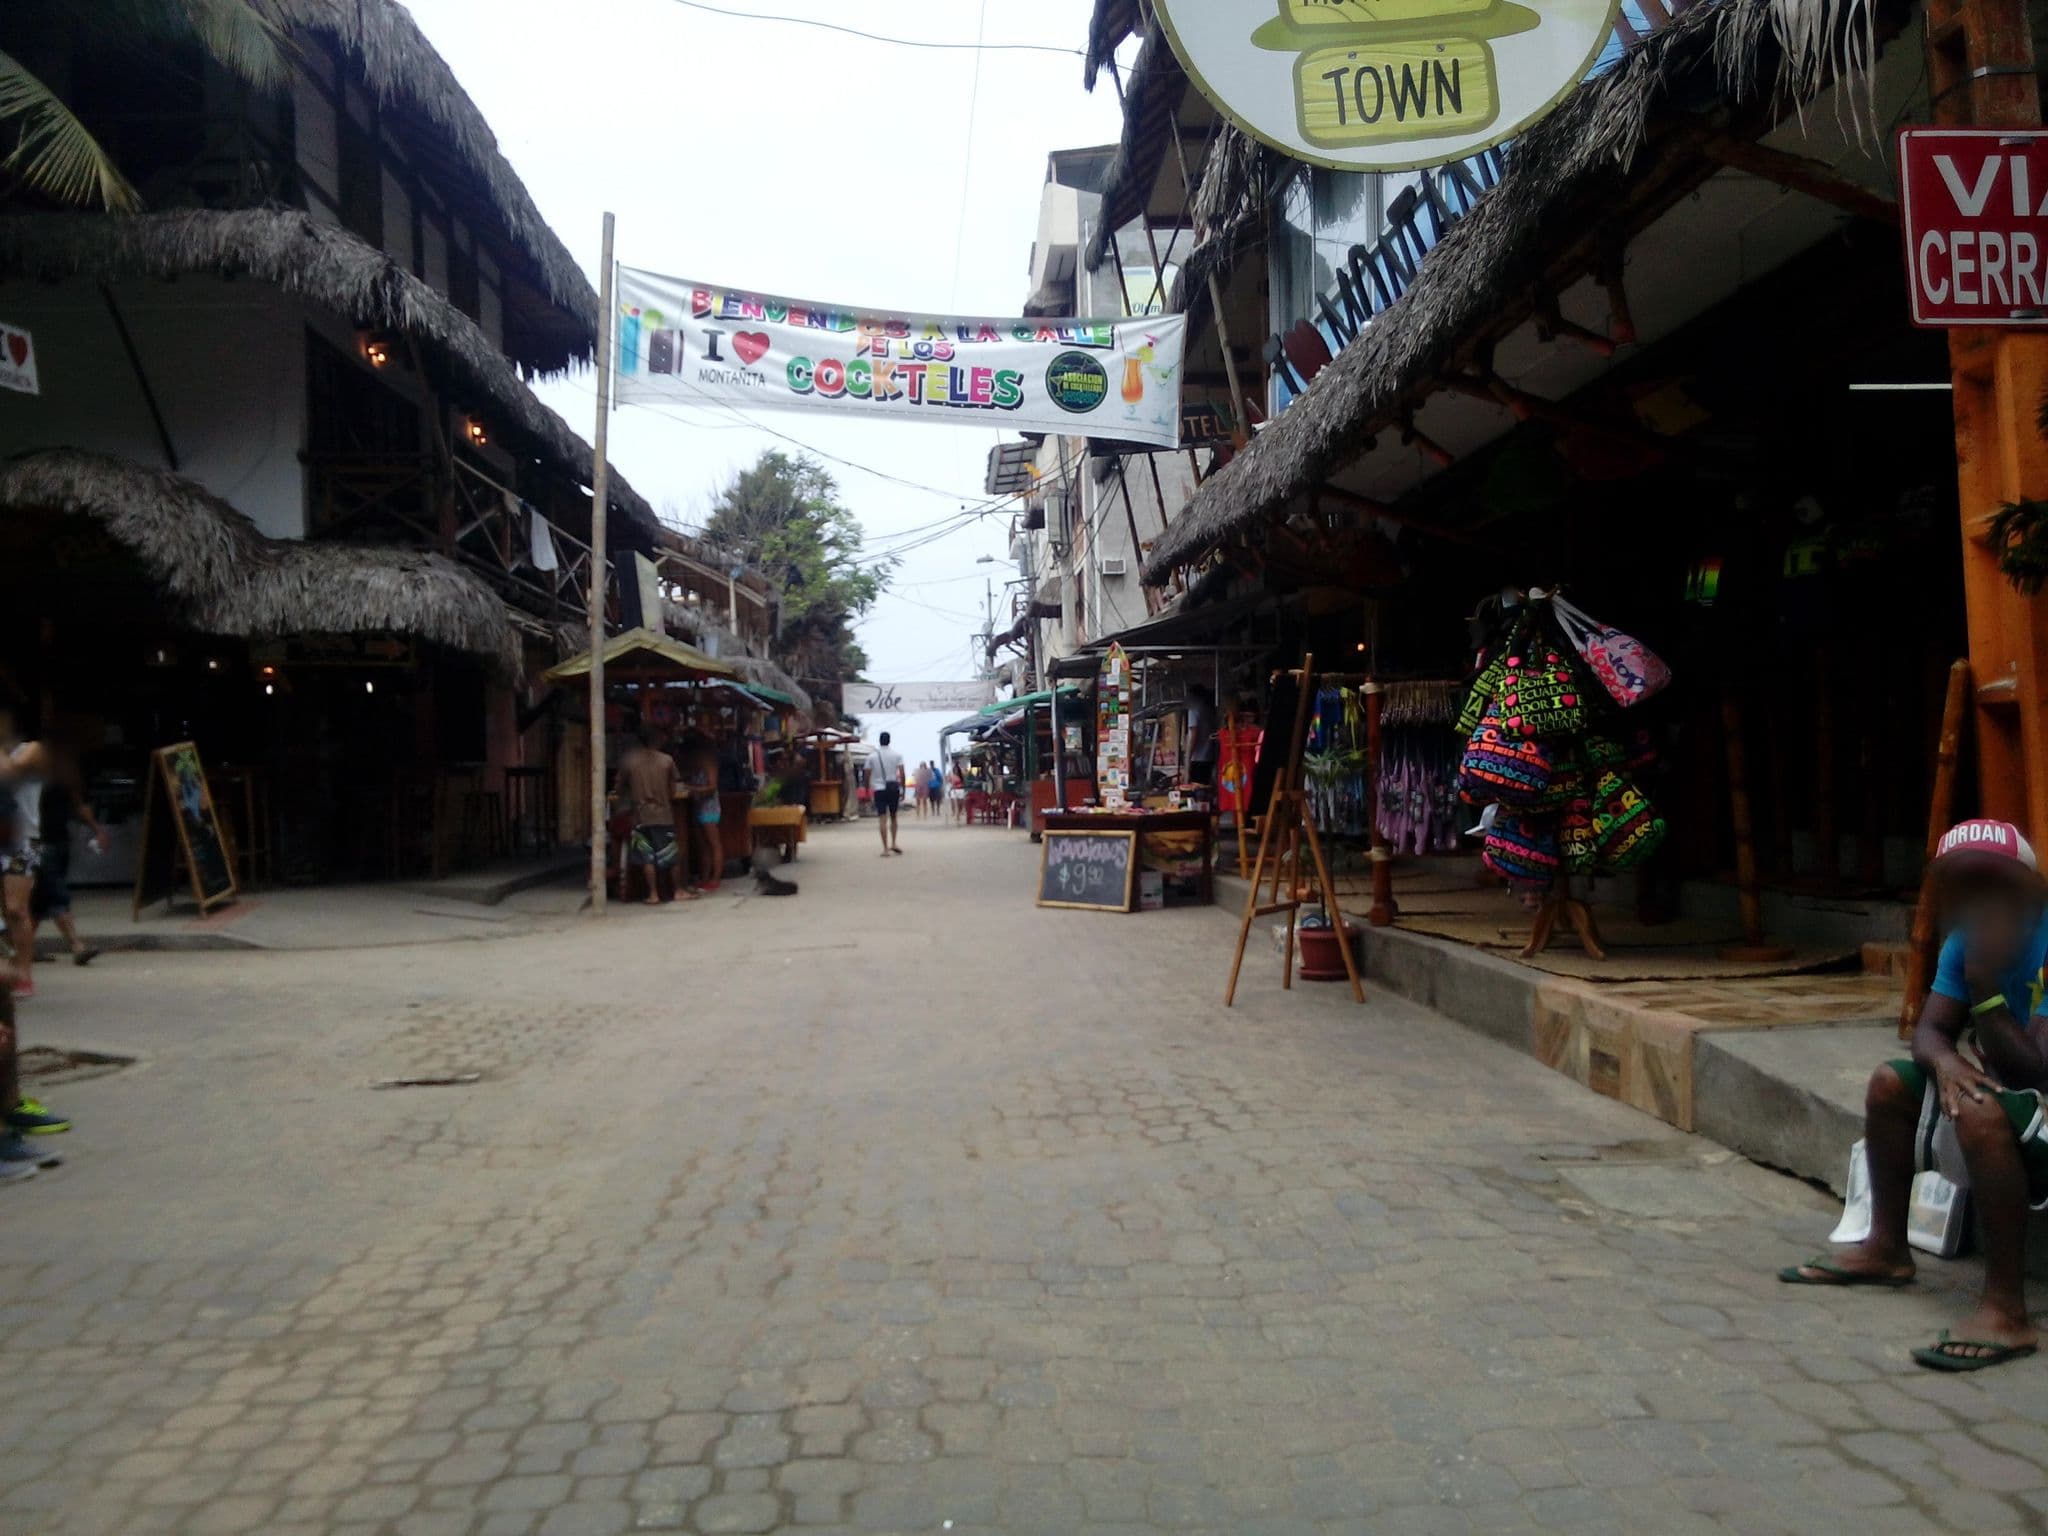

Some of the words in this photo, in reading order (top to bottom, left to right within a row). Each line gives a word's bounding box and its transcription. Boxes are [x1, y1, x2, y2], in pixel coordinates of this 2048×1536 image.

[1322, 58, 1463, 126] TOWN
[1918, 229, 2048, 306] CERR
[701, 327, 726, 362] I
[898, 340, 956, 362] LOS
[1011, 323, 1115, 350] CALLE
[698, 366, 766, 387] MONTAÑITA
[785, 355, 1025, 411] COCKTELES
[1941, 822, 2007, 855] JORDAN
